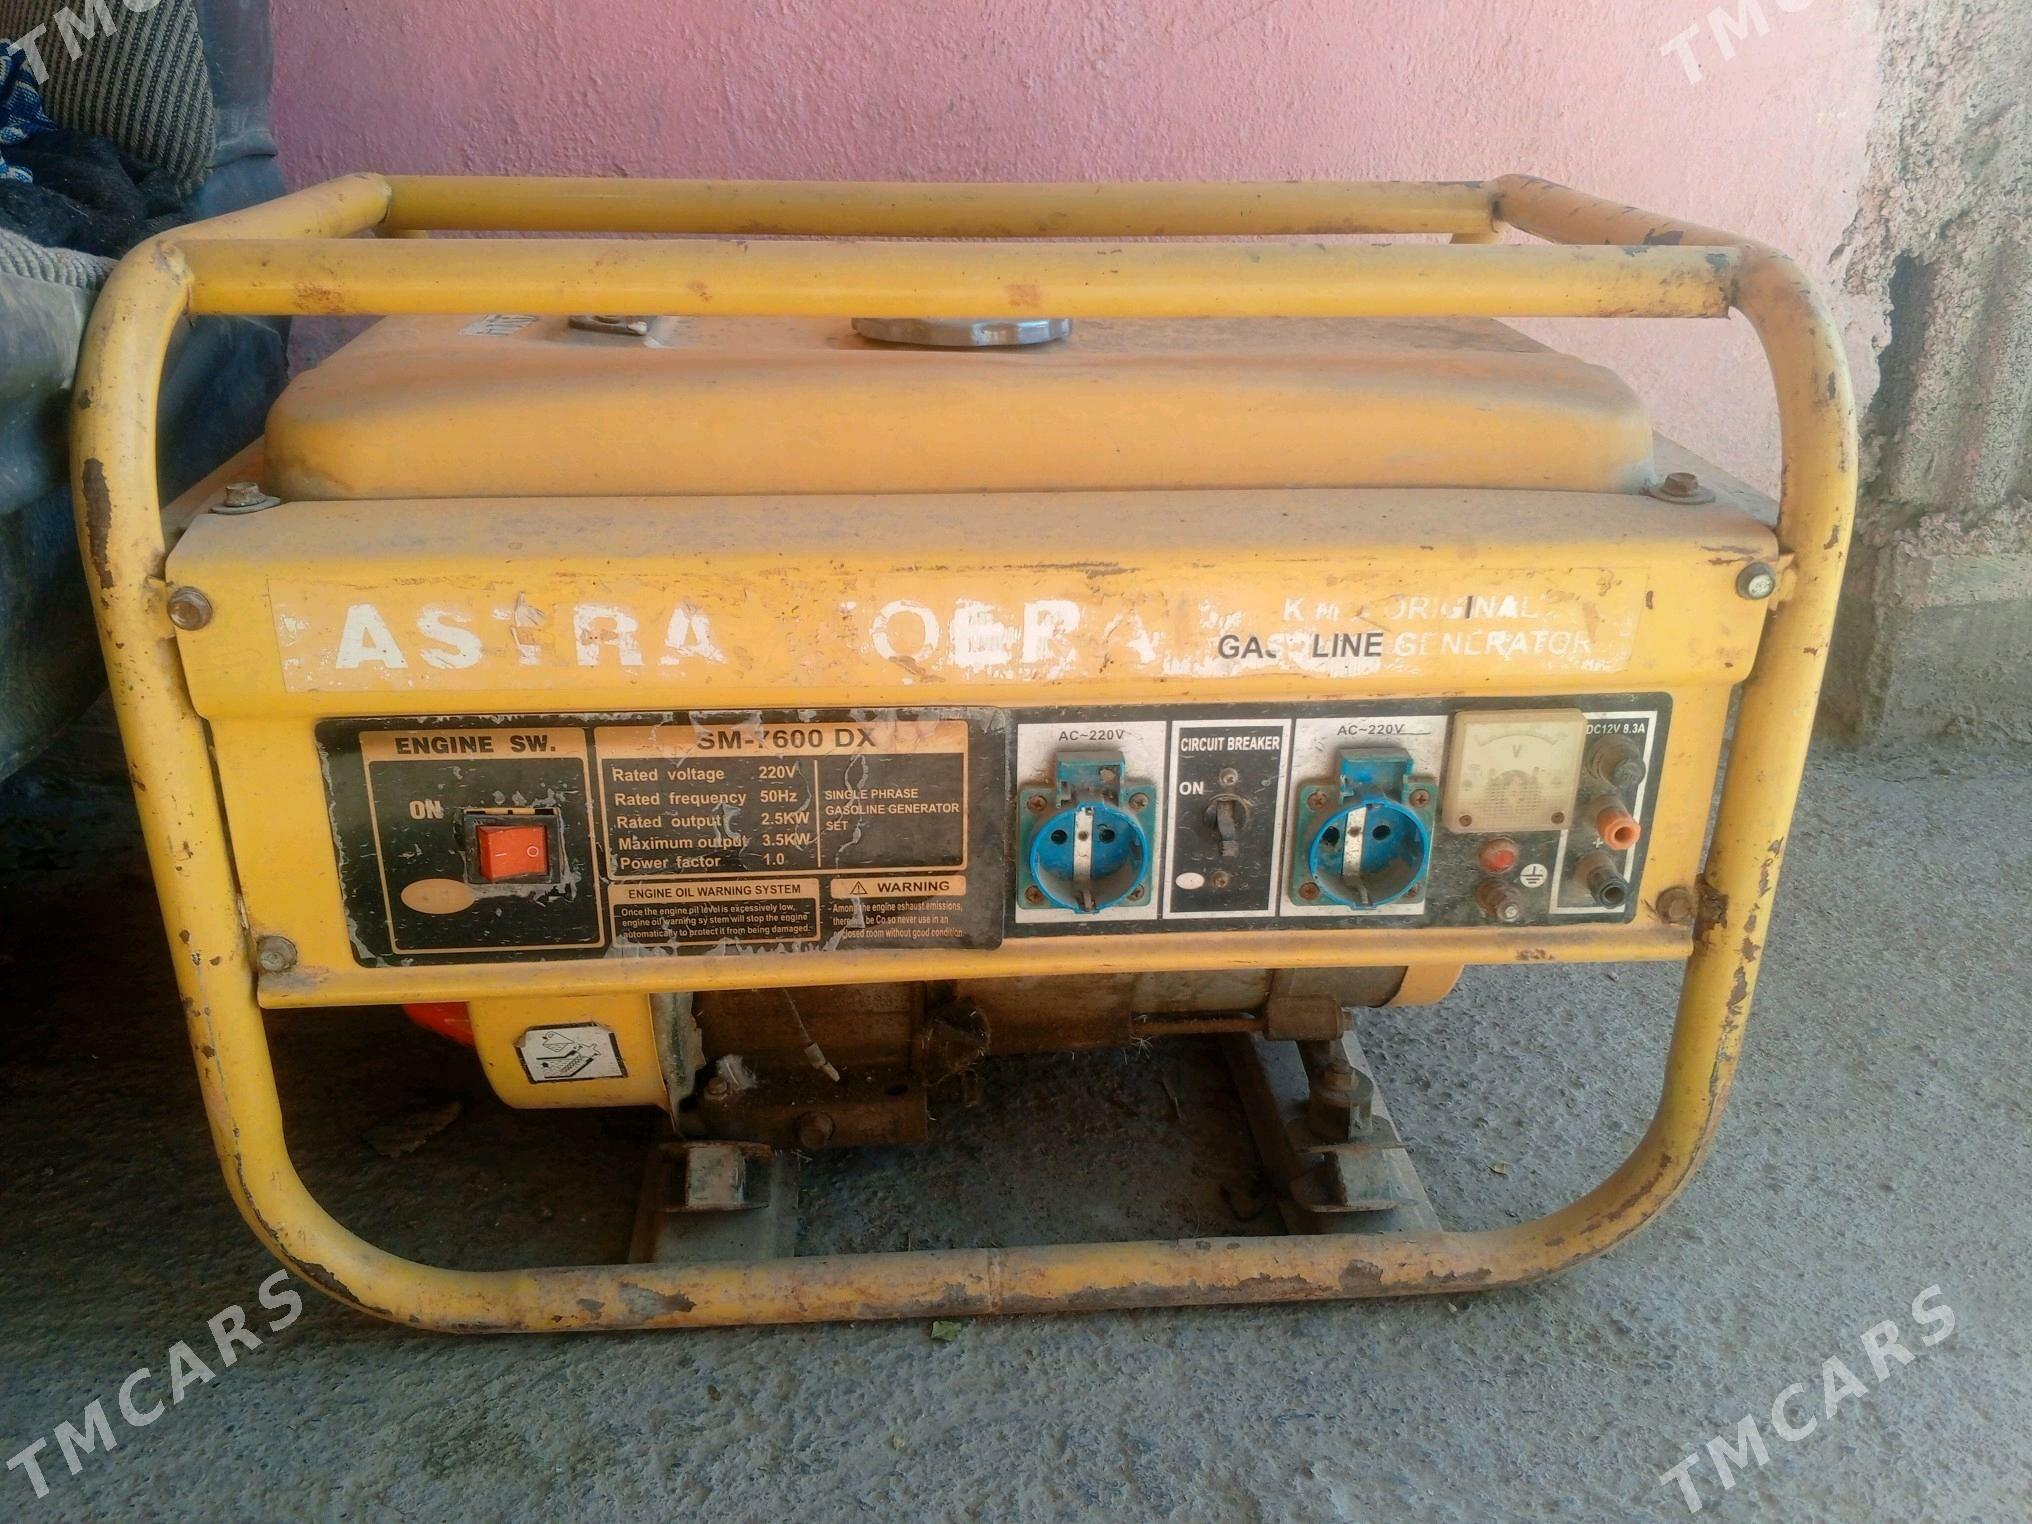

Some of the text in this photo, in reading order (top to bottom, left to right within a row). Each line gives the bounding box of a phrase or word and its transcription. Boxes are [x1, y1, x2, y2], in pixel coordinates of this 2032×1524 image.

[1586, 723, 1646, 735] DC12V 8.3A
[395, 734, 556, 754] ENGINE SW.
[834, 728, 876, 748] DX
[1180, 736, 1281, 752] CIRCUIT BREAKER
[612, 766, 796, 783] Rated voltage 220V
[824, 788, 919, 801] SINGLE PHRASE
[1178, 781, 1204, 796] ON
[614, 790, 798, 807] Rated frequency 50Hz
[409, 800, 444, 819] ON
[825, 803, 960, 816] GASOLINE GENERATOR
[616, 812, 810, 830] Rated output 2.5KW
[825, 820, 848, 831] SET
[618, 833, 810, 851] Maximum output 3.5KW
[620, 853, 785, 870] Power factor 1.0
[628, 884, 801, 899] ENGINE OIL WARNING SYSTEM
[877, 881, 950, 893] WARNING
[621, 908, 643, 916] Once
[644, 907, 658, 916] the
[659, 907, 687, 916] engine
[721, 905, 729, 913] is
[730, 904, 778, 913] excessively
[872, 902, 896, 913] engine
[622, 918, 651, 928] engine
[651, 918, 662, 926] oil
[730, 915, 745, 923] will
[746, 915, 765, 923] stop
[766, 914, 779, 922] the
[780, 913, 808, 923] engine
[865, 915, 875, 925] be
[897, 916, 916, 924] never
[918, 915, 931, 924] use
[679, 928, 688, 936] to
[689, 928, 718, 938] protect
[726, 926, 746, 935] from
[747, 925, 770, 935] being
[833, 929, 865, 938] elosed
[885, 928, 911, 938] without
[912, 928, 930, 939] good
